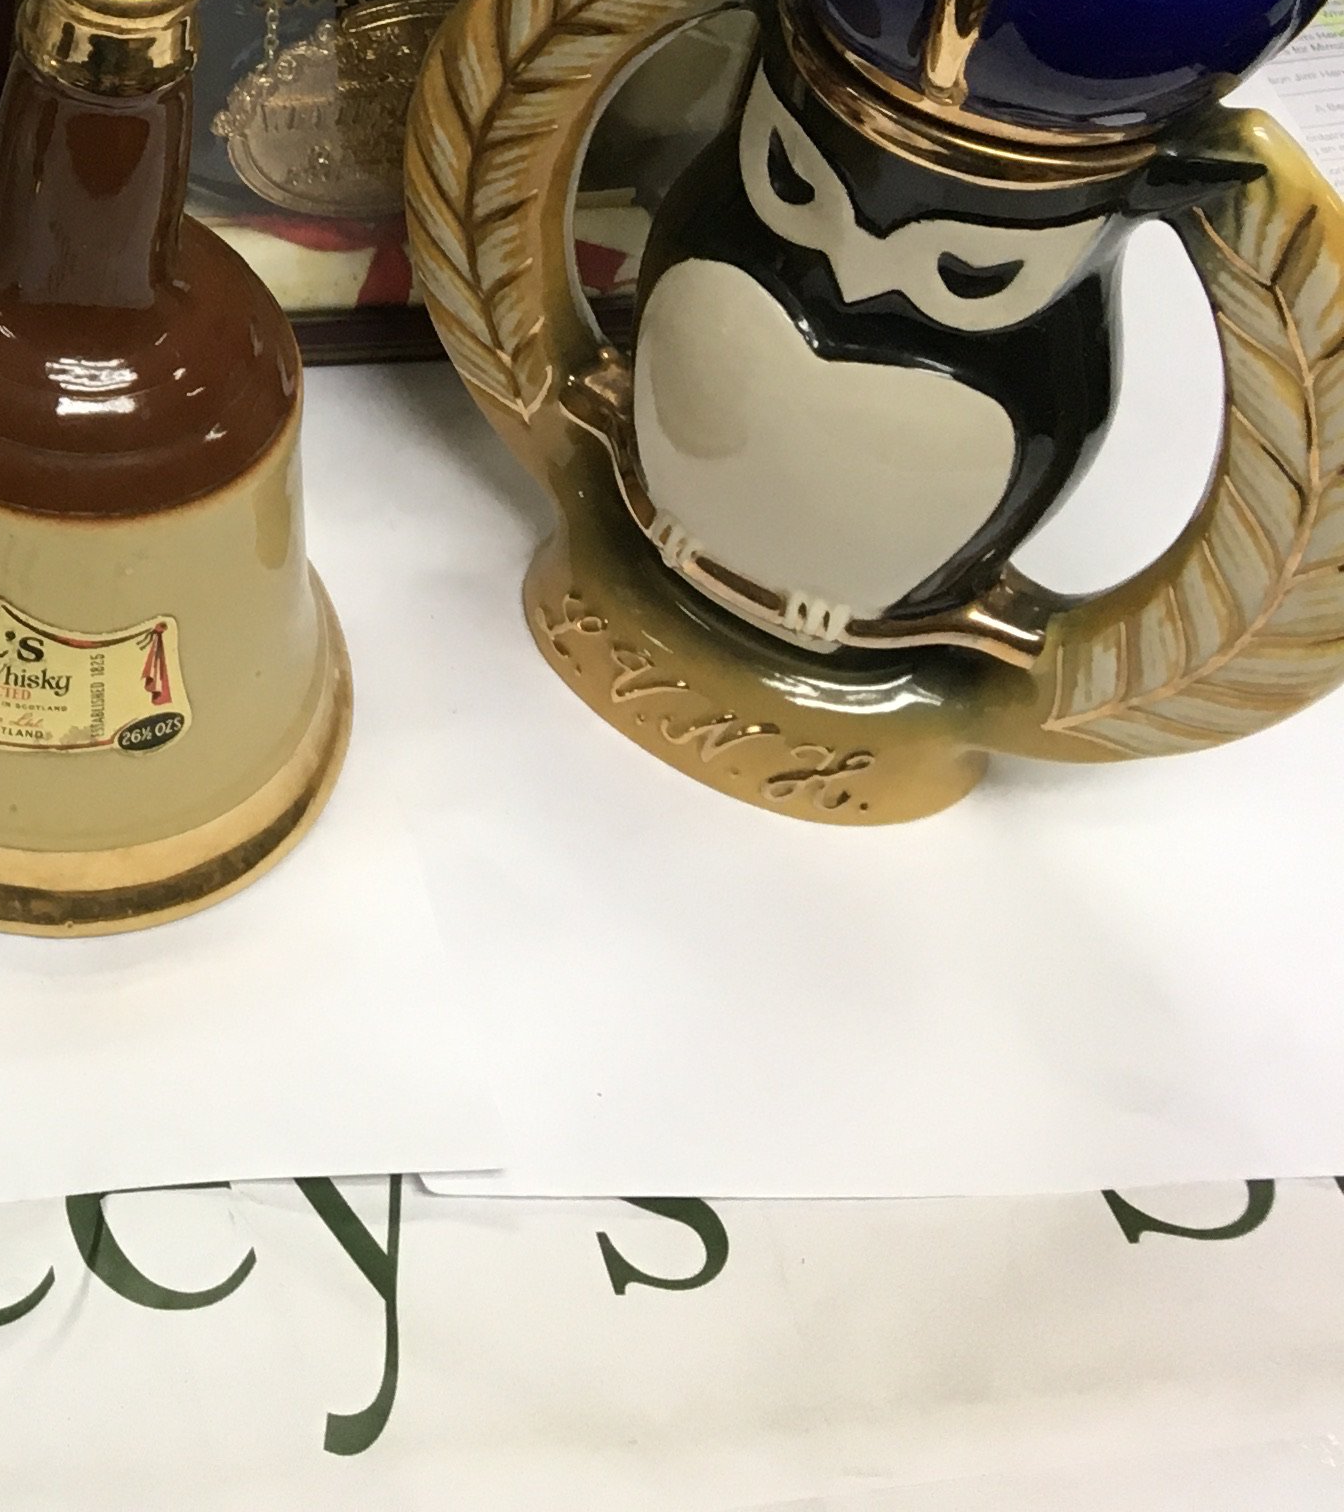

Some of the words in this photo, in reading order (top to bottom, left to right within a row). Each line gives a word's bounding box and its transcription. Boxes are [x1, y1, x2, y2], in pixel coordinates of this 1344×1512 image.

[90, 653, 105, 677] 1825
[15, 702, 68, 712] SCOTLAND
[90, 682, 105, 738] ESTABLISHED
[121, 726, 152, 746] 26½
[155, 716, 182, 737] OZS
